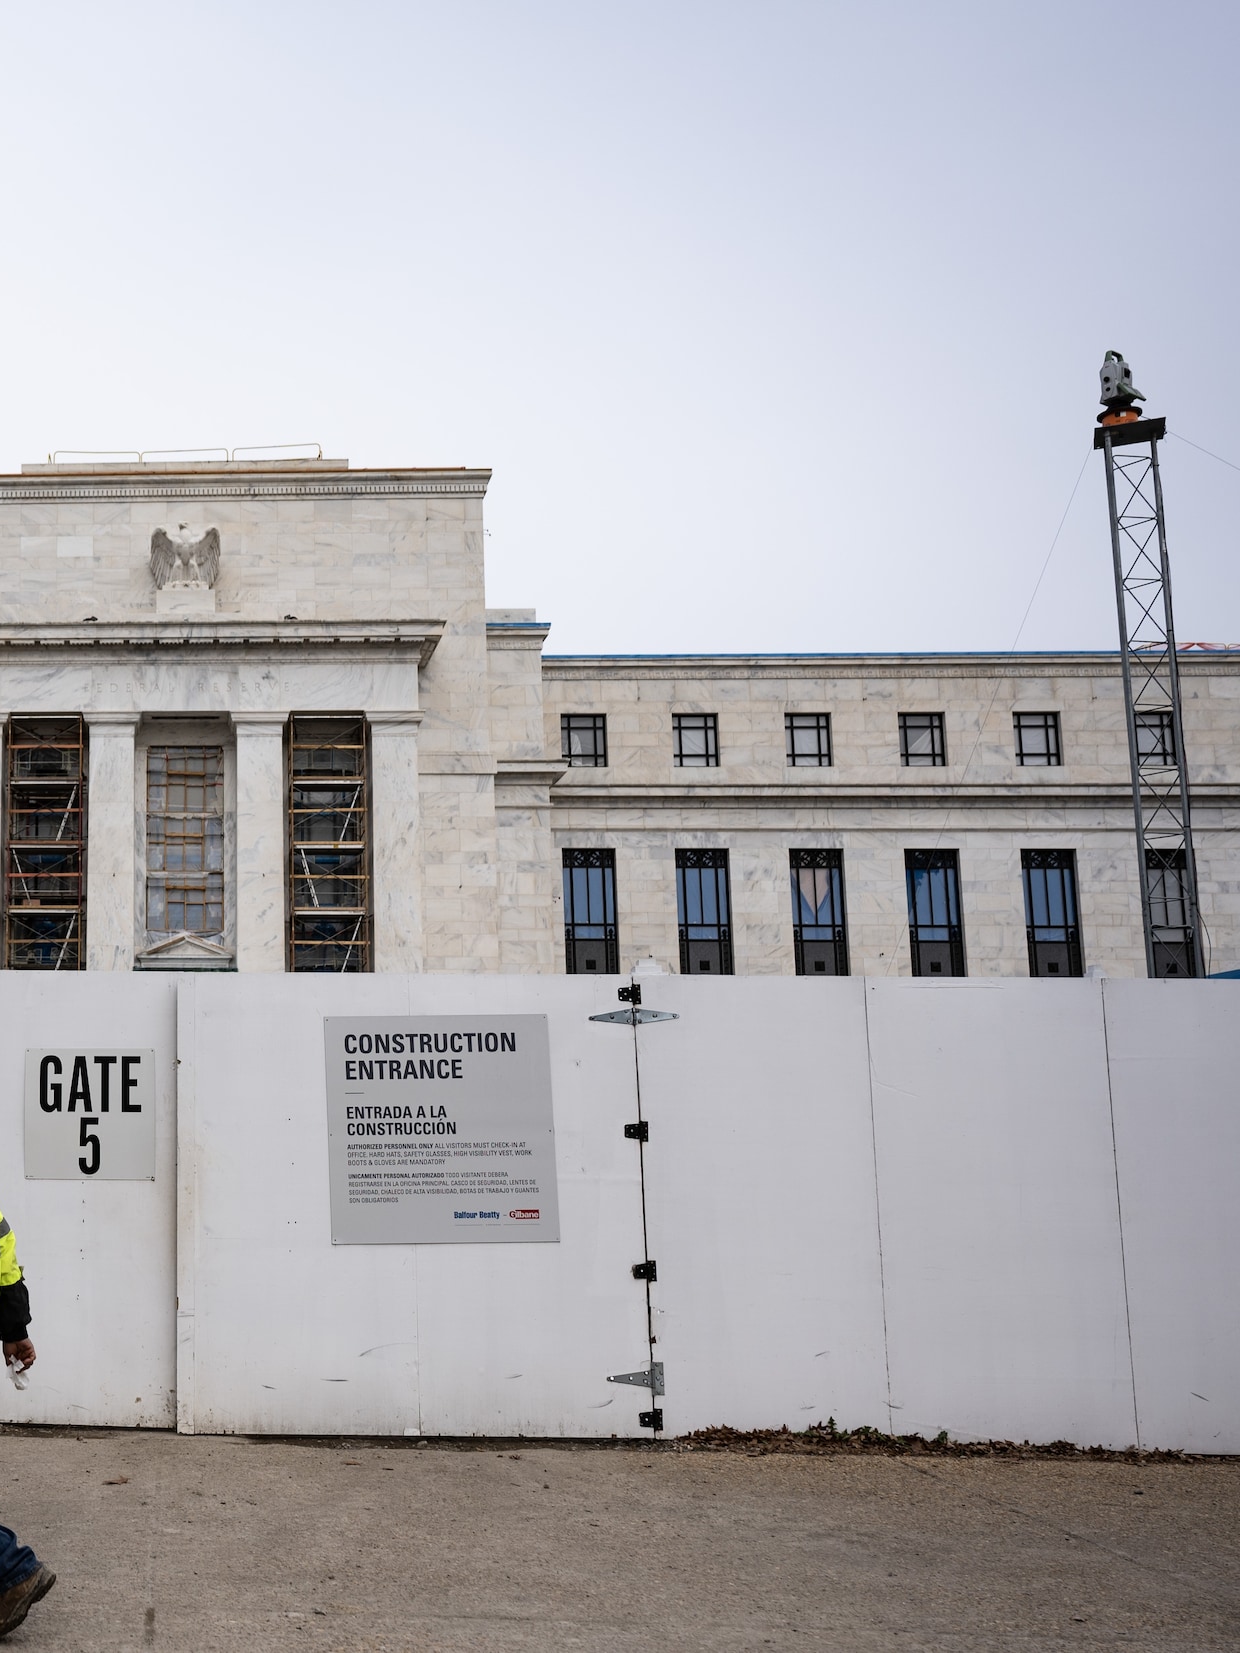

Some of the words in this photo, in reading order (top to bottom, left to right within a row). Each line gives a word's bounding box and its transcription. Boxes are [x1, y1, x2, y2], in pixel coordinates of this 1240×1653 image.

[84, 682, 176, 692] FEDERAL
[198, 682, 290, 692] RESERVE
[345, 1033, 516, 1054] CONSTRUCTION
[345, 1059, 463, 1080] ENTRANCE
[40, 1055, 142, 1113] GATE
[347, 1106, 412, 1119] ENTRADA
[416, 1106, 426, 1119] A
[431, 1106, 447, 1118] LA
[348, 1119, 456, 1136] CONSTRUCCIÓN
[79, 1117, 100, 1175] 5
[454, 1211, 477, 1219] Balfour
[479, 1211, 500, 1219] Beatty
[510, 1210, 539, 1219] Gilbane
